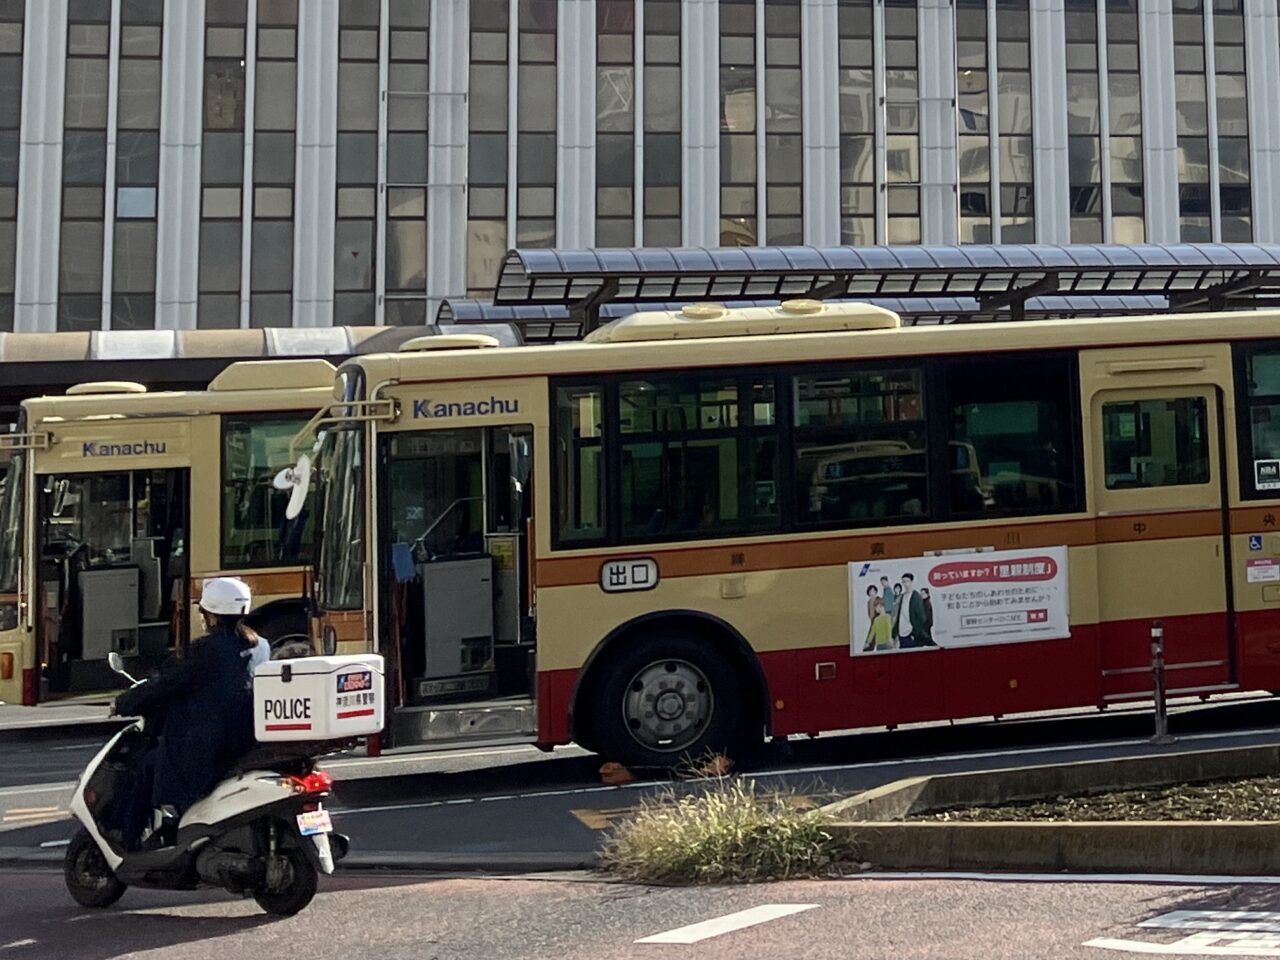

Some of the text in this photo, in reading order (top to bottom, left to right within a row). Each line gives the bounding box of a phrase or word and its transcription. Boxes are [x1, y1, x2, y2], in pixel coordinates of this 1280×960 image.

[413, 396, 519, 419] Kanachu
[82, 440, 167, 457] Kanachu
[609, 564, 649, 586] 出口
[264, 698, 311, 720] POLICE
